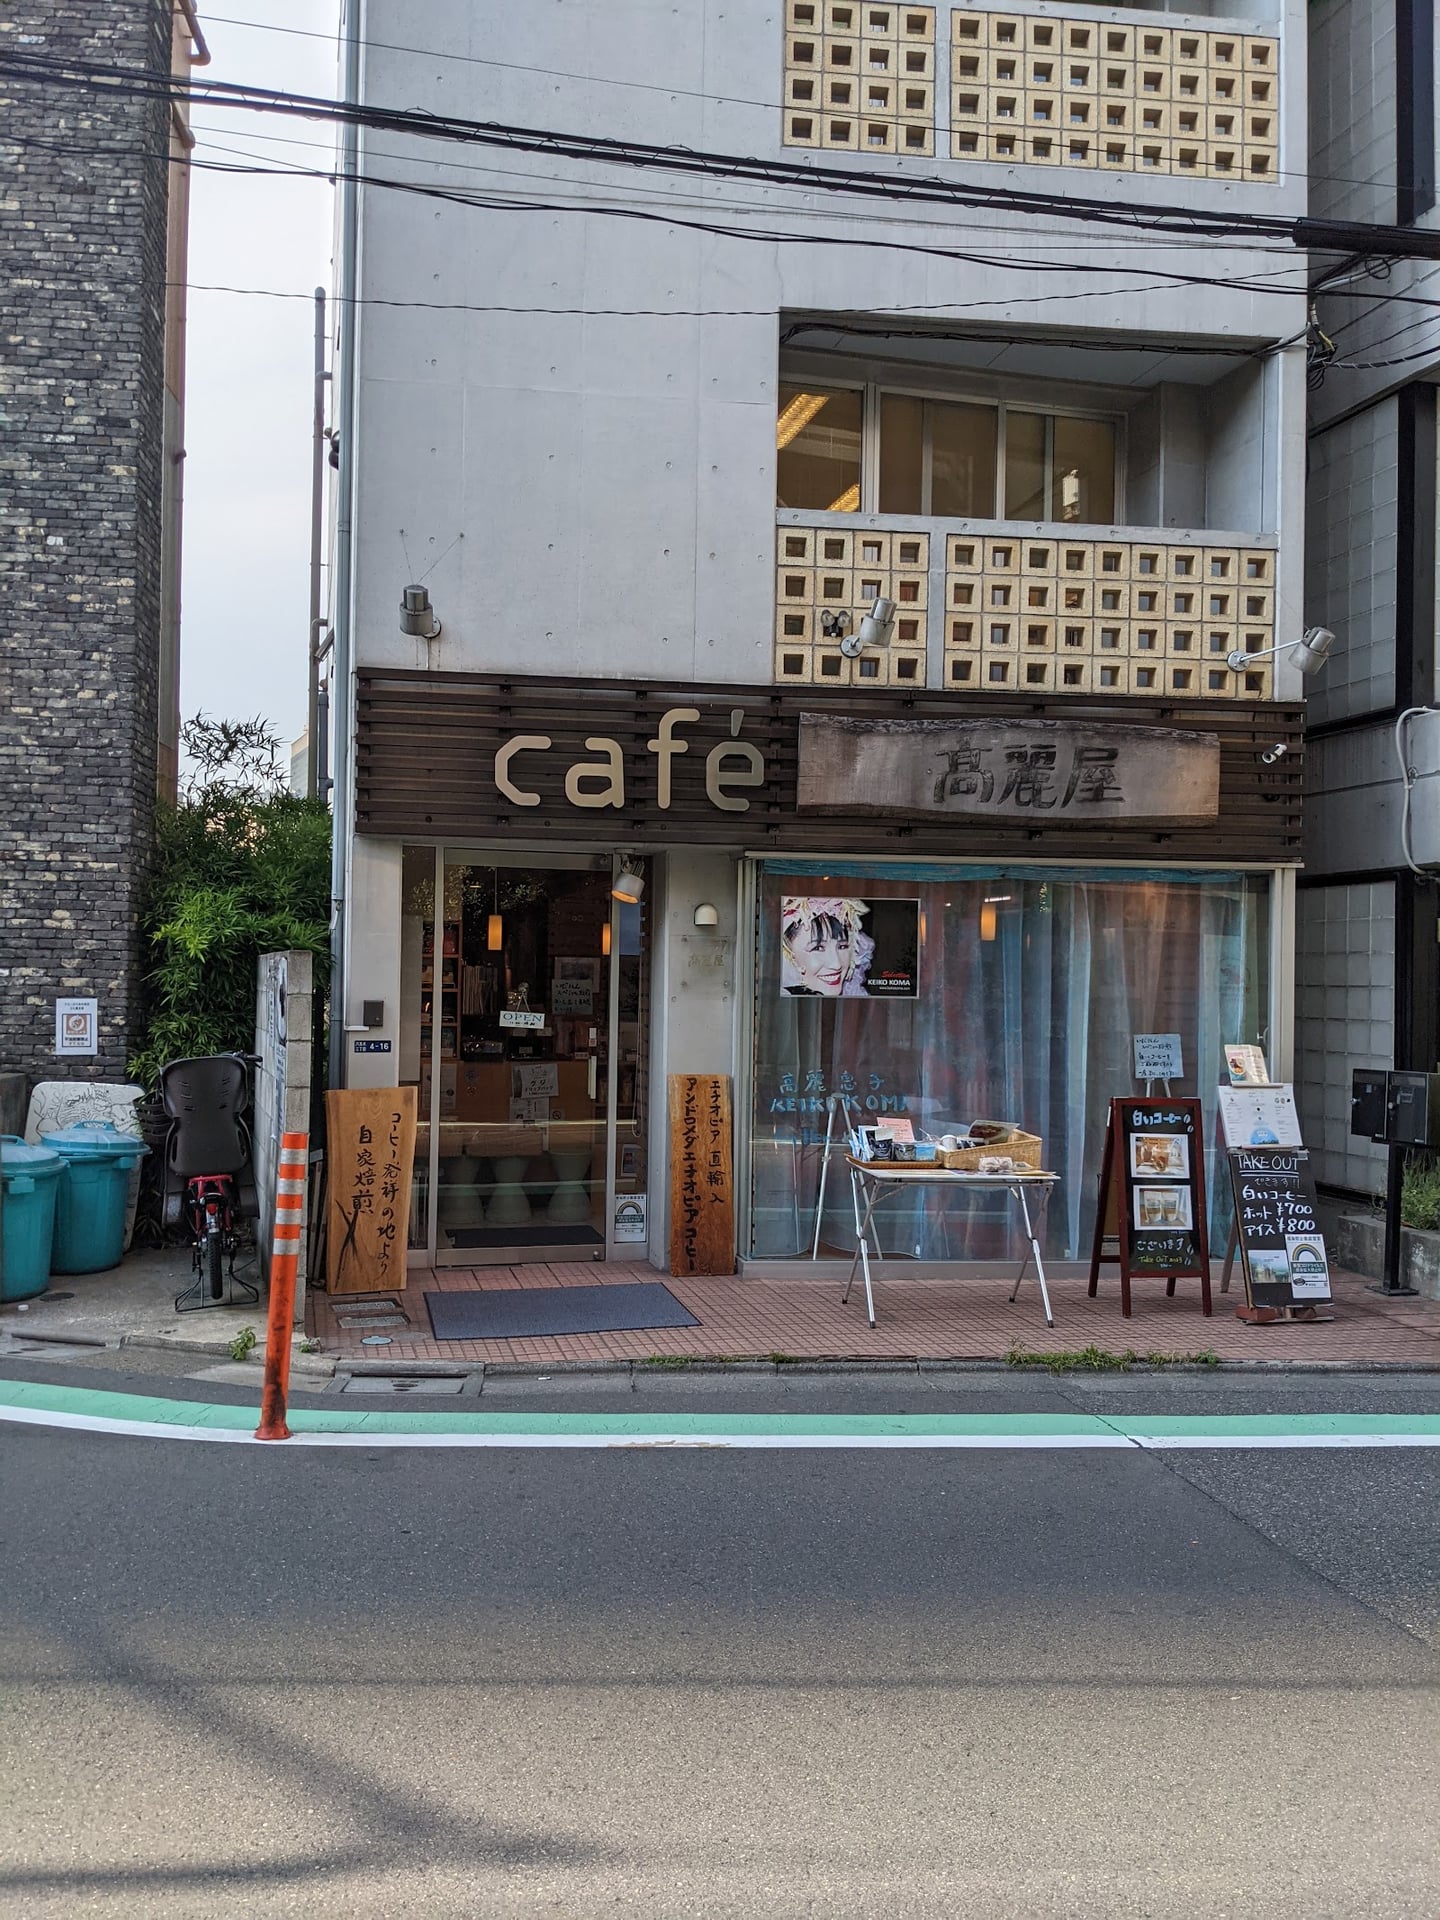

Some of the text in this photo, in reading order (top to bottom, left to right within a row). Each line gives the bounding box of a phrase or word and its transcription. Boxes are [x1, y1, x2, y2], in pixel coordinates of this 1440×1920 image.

[495, 708, 764, 811] café
[933, 738, 1125, 808] 高麗屋
[867, 978, 888, 986] KEIKO
[503, 1012, 543, 1022] OPEN
[369, 1042, 390, 1051] 4-16
[347, 1124, 377, 1214] 自家焙煎
[1233, 1155, 1299, 1170] TAKE OUT
[1242, 1184, 1307, 1200] 白いコーヒー
[1243, 1205, 1272, 1219] ホット
[1243, 1223, 1276, 1237] アイス
[1137, 1237, 1184, 1251] ございます
